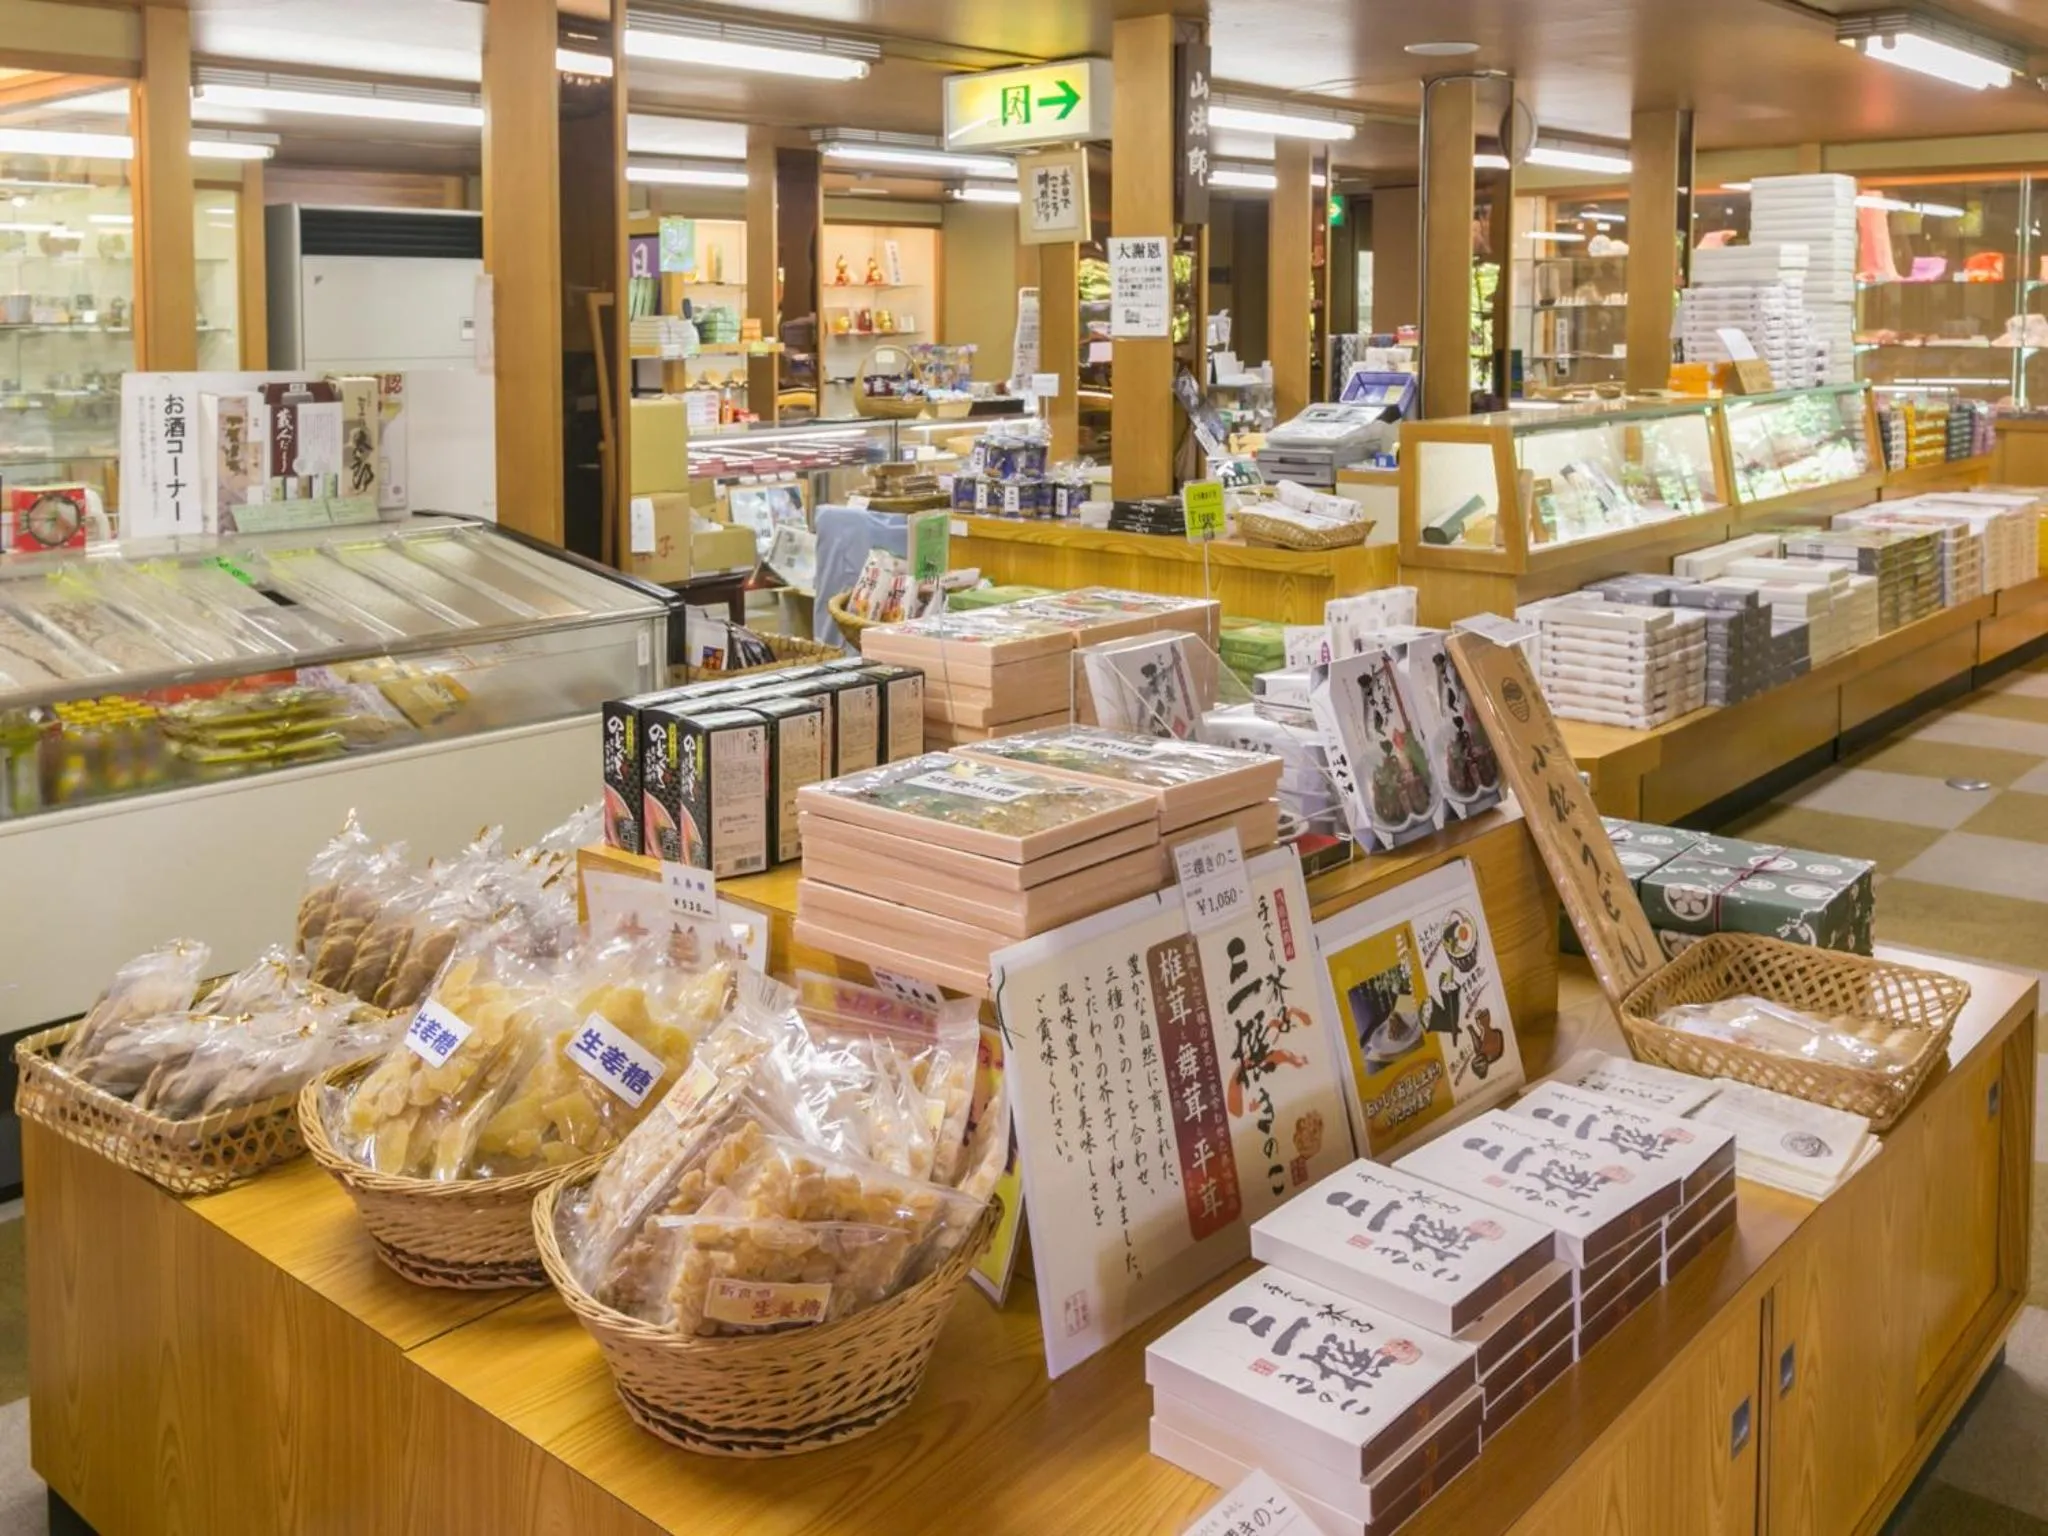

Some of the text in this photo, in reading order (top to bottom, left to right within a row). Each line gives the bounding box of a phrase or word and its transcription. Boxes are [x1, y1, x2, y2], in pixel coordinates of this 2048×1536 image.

[164, 394, 187, 521] お酒コーナー
[409, 1013, 459, 1056] 生姜糖
[575, 1028, 654, 1095] 生姜糖
[1035, 993, 1074, 1163] ご賞味ください。
[1057, 982, 1104, 1227] 風味豊かな美味しさを
[1105, 965, 1156, 1195] 三種のきのこを合わせ、
[1127, 952, 1179, 1186] 豊かな自然に育まれた、
